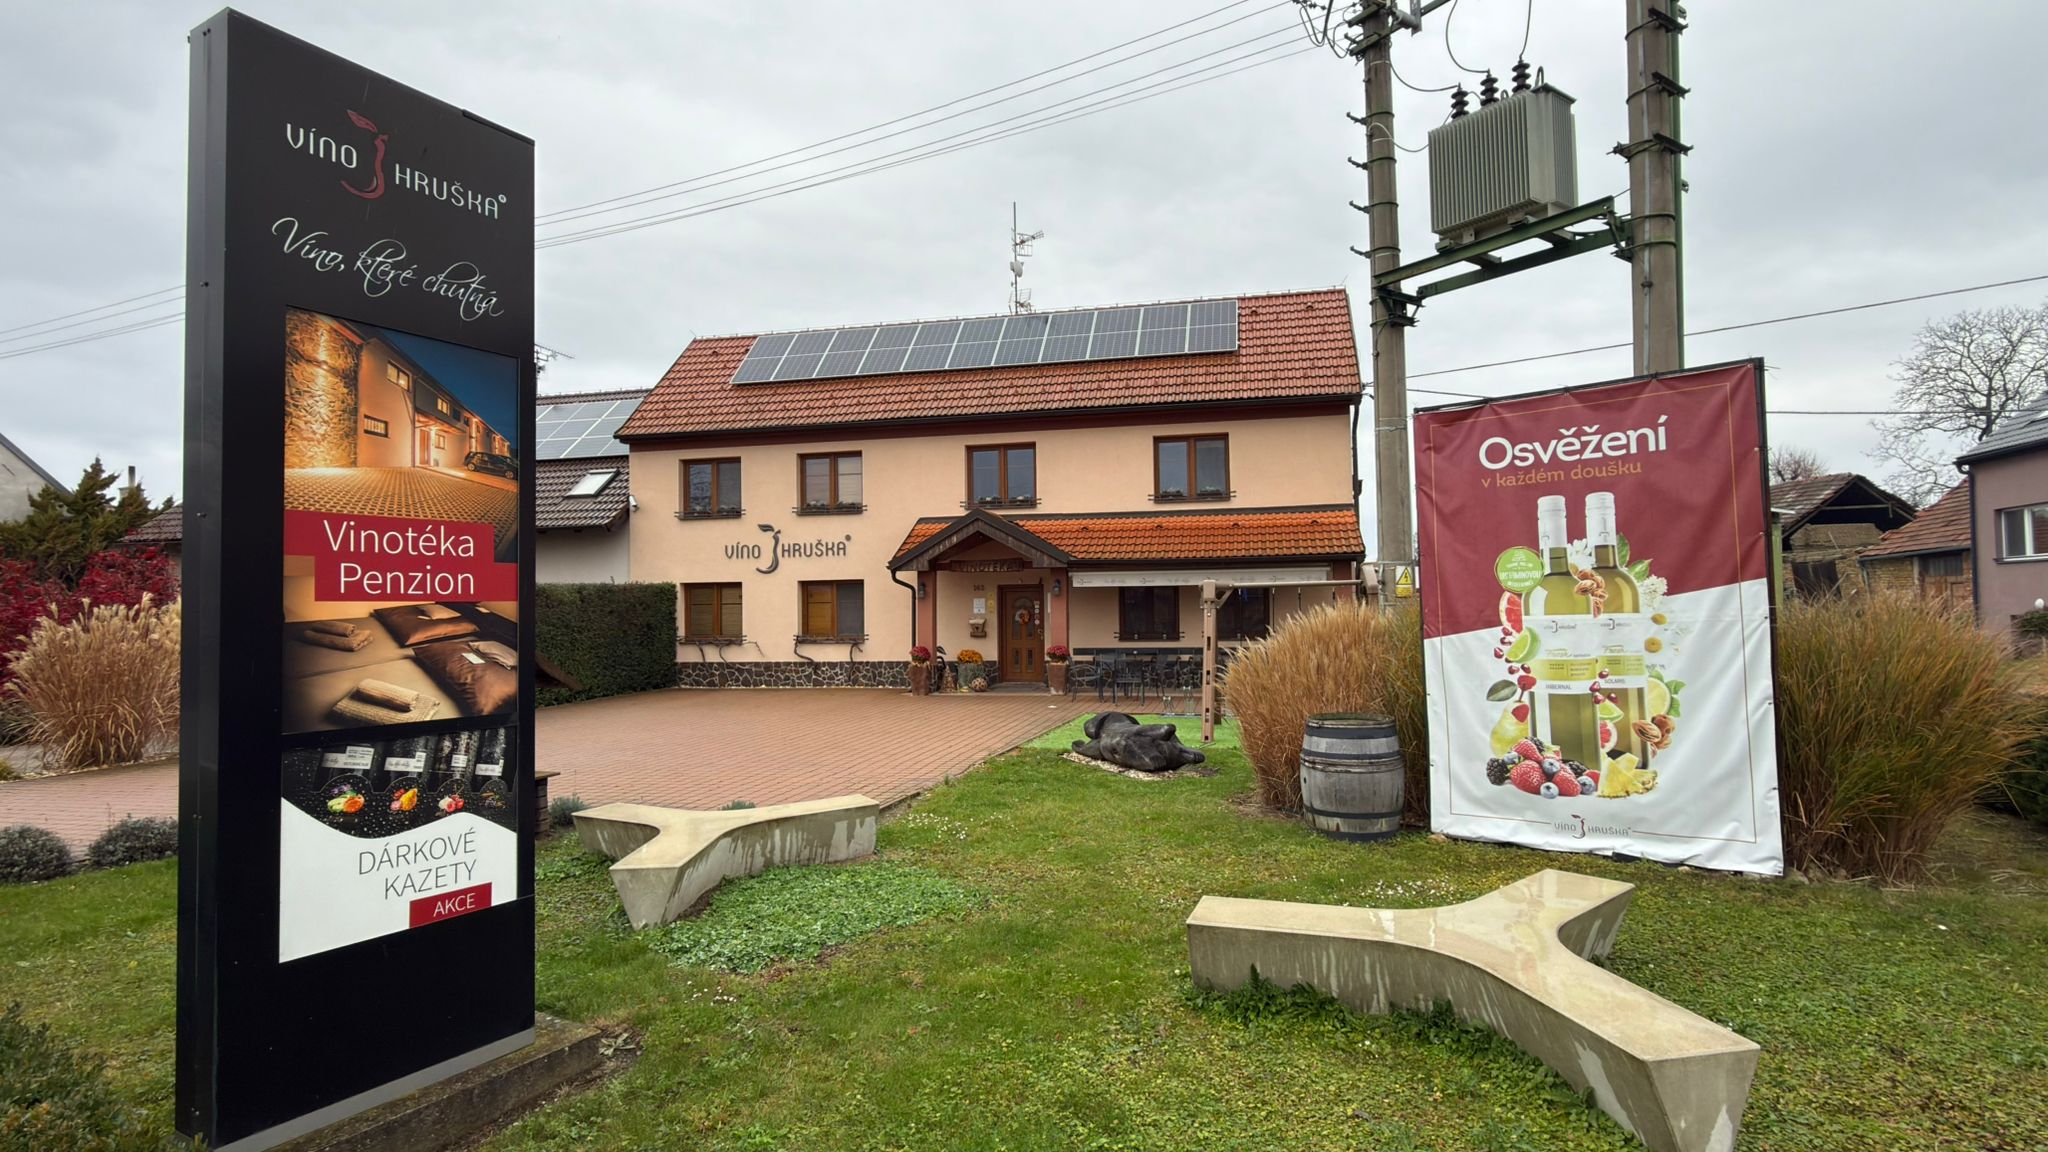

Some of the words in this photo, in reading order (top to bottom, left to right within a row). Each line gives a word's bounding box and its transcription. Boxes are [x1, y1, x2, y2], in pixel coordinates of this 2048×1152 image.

[271, 217, 345, 273] Víno,
[353, 238, 418, 297] které
[422, 260, 505, 322] chutná
[1478, 414, 1669, 471] Osvěžení
[1481, 477, 1491, 489] v
[1496, 467, 1565, 488] každém
[1570, 459, 1643, 481] doušku
[323, 519, 475, 558] Vinotéka
[340, 562, 475, 595] Penzion
[359, 827, 477, 875] DÁRKOVÉ
[385, 859, 477, 900] KAZETY
[433, 892, 476, 918] AKCE
